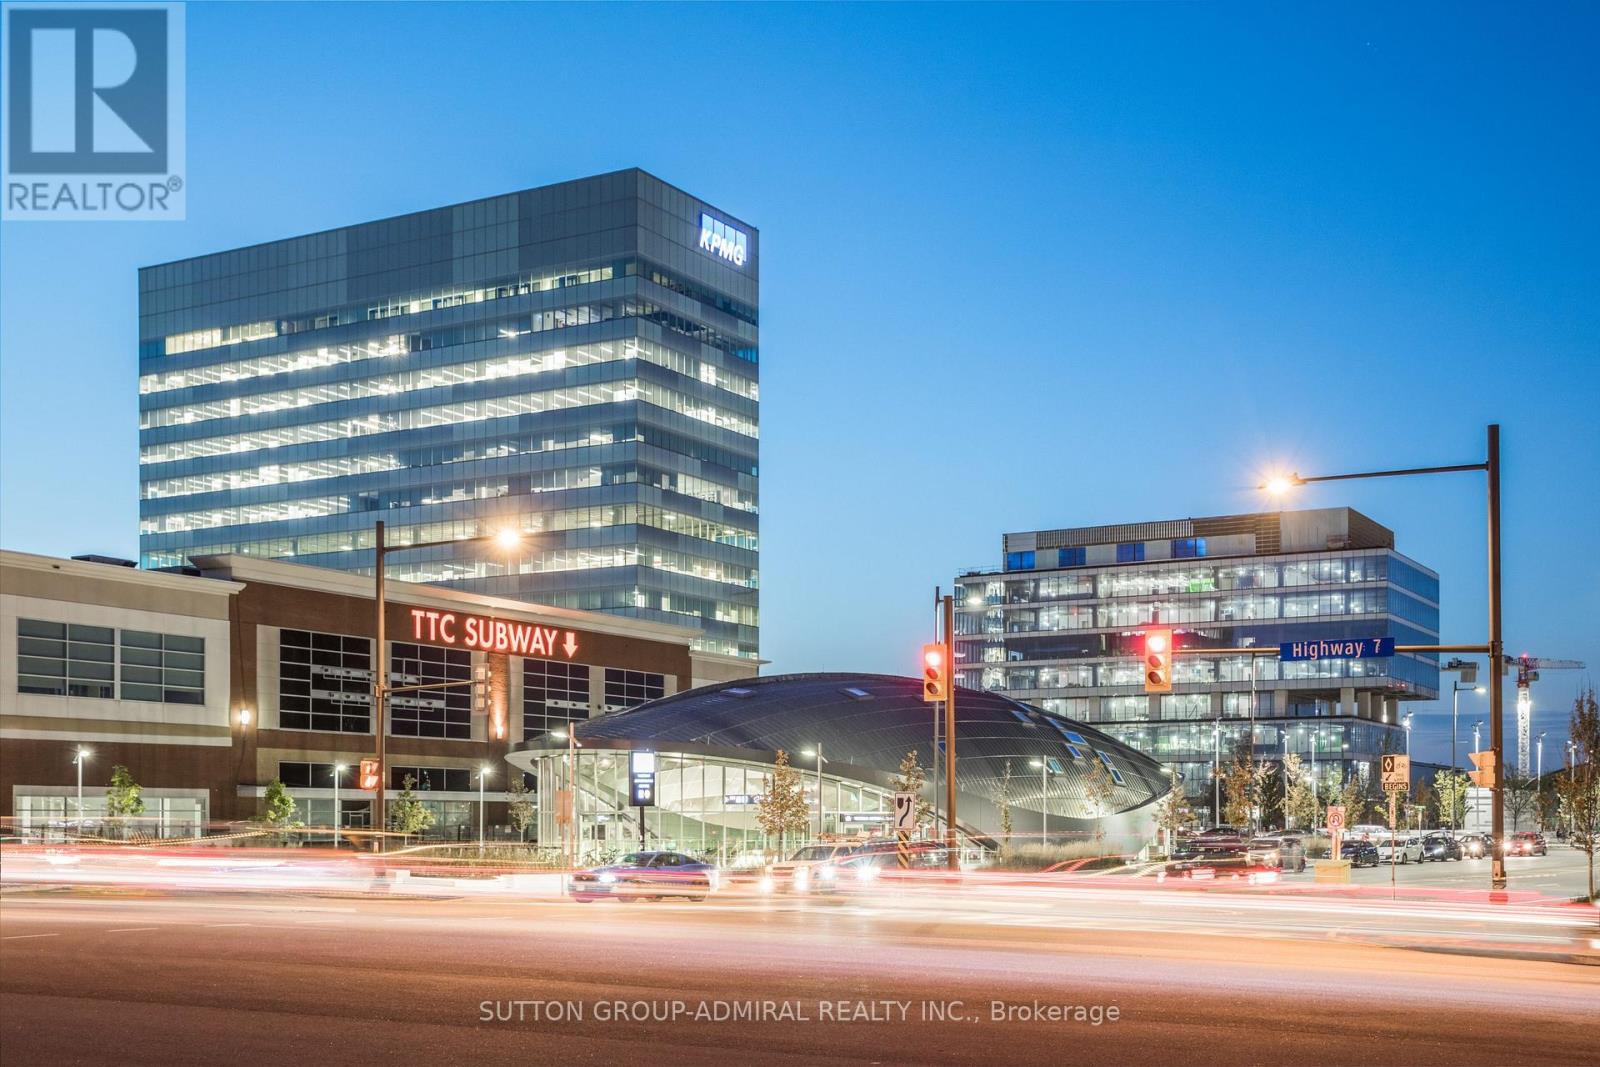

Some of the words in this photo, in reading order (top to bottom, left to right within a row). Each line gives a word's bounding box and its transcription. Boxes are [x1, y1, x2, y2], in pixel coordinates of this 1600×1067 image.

[700, 228, 744, 266] KPMG
[411, 609, 456, 644] TTC
[464, 617, 558, 656] SUBWAY
[1292, 640, 1364, 660] Highway
[1373, 638, 1382, 654] 7
